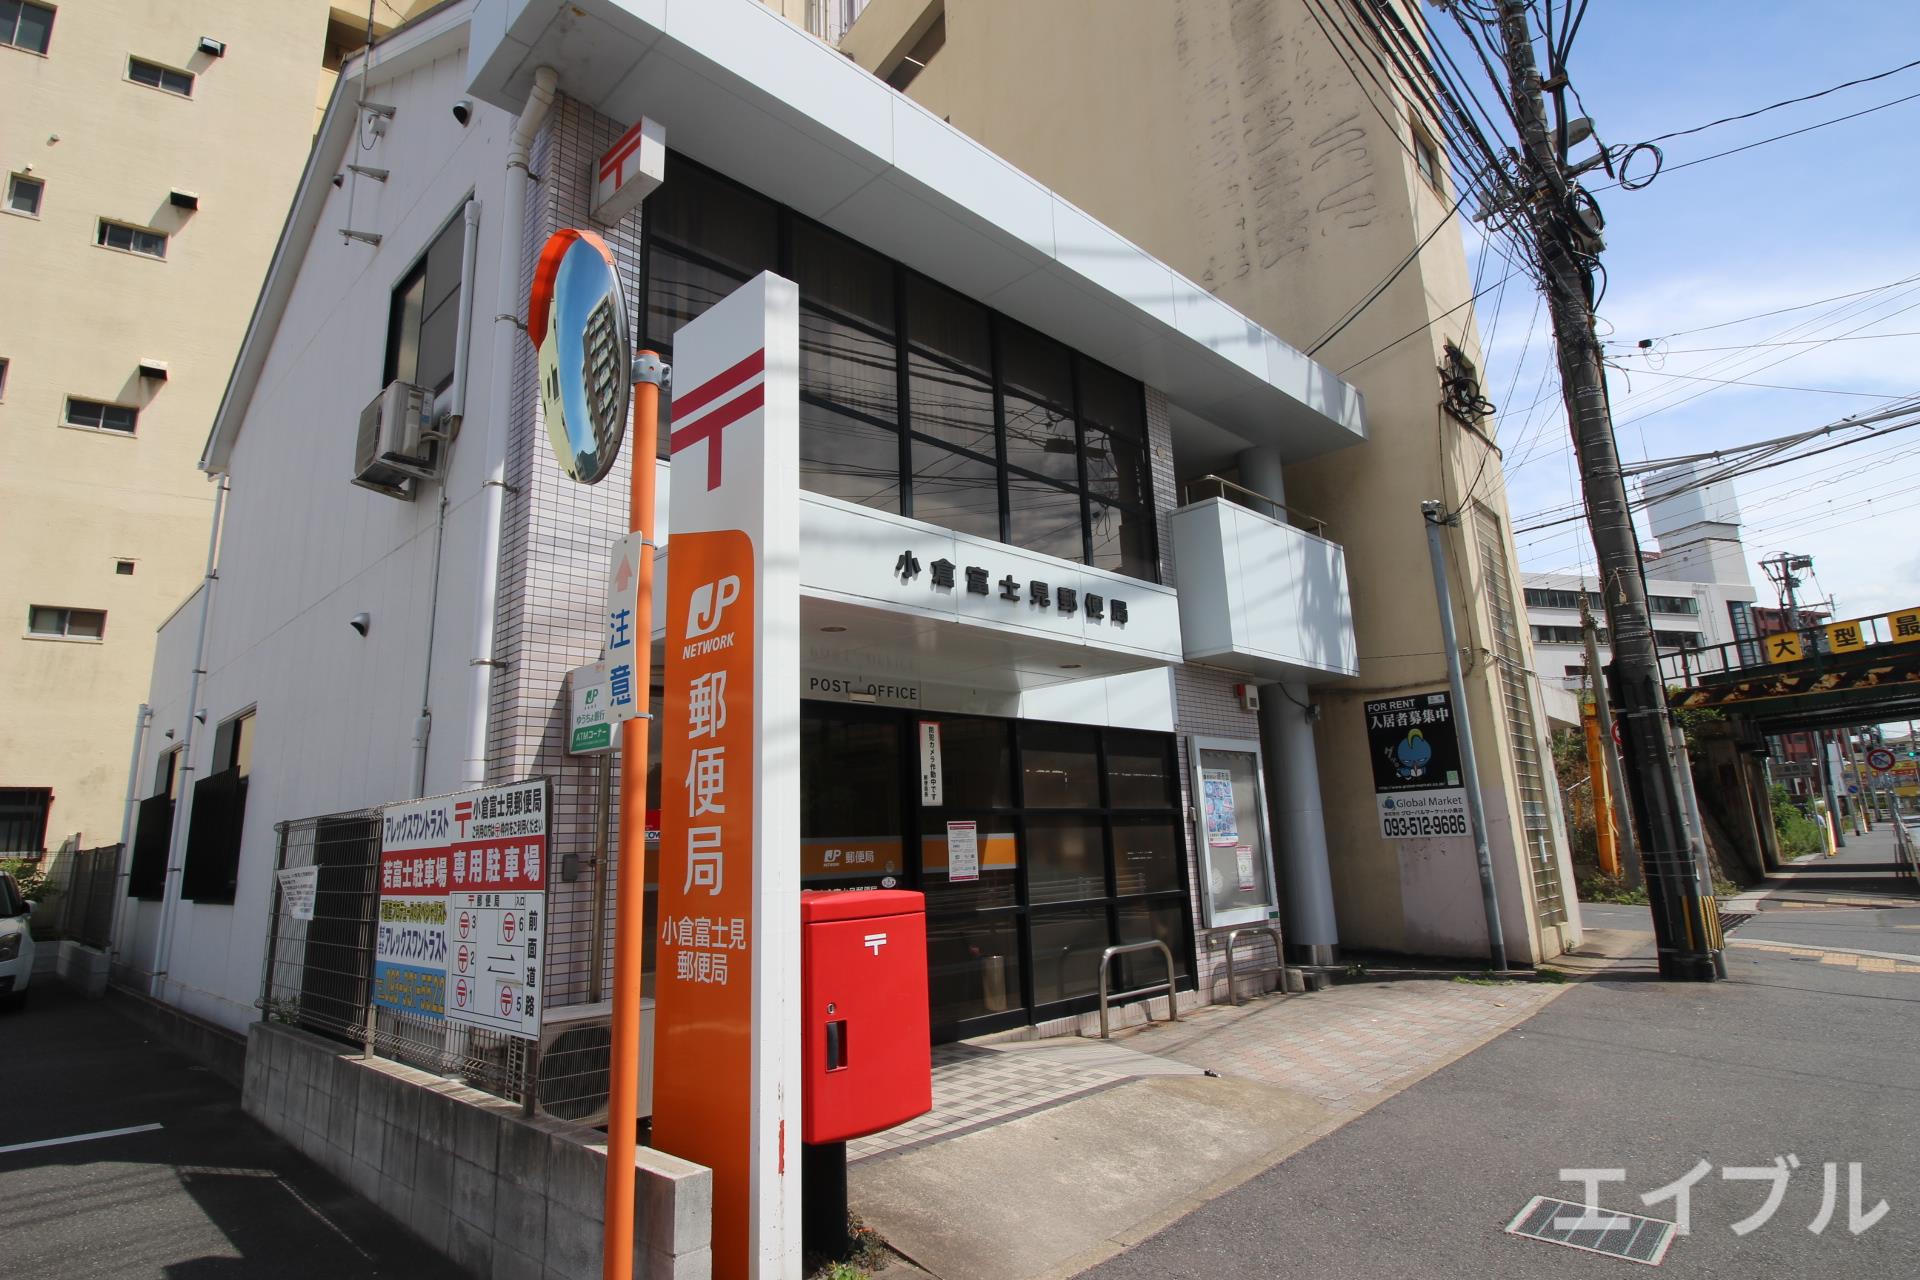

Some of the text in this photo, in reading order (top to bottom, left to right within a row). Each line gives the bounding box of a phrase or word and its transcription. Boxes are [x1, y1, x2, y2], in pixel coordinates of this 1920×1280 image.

[897, 550, 1128, 624] 小倉富士見郵便局
[609, 608, 631, 707] 注意
[682, 632, 735, 660] NETWORK
[810, 677, 917, 699] POST OFFICE
[1367, 703, 1387, 713] FOR
[1389, 699, 1416, 710] RENT
[1371, 707, 1449, 730] 入居者募集中
[683, 670, 728, 896] 郵便局
[473, 788, 542, 820] 小倉富士見郵便局
[1396, 796, 1463, 808] Global Market
[385, 807, 448, 844] アレックスワントラスト
[1384, 815, 1467, 837] 093-512-9686
[453, 844, 540, 884] 専用駐車場
[845, 851, 875, 864] 郵便局
[383, 857, 448, 889] 若富士駐車場
[477, 894, 500, 907] 郵便局
[471, 915, 477, 928] 3
[518, 917, 524, 932] 6
[662, 915, 746, 950] 小倉富士見
[470, 951, 475, 965] 2
[525, 910, 538, 1017] 前面道路
[677, 950, 728, 985] 郵便局
[516, 996, 522, 1012] 5
